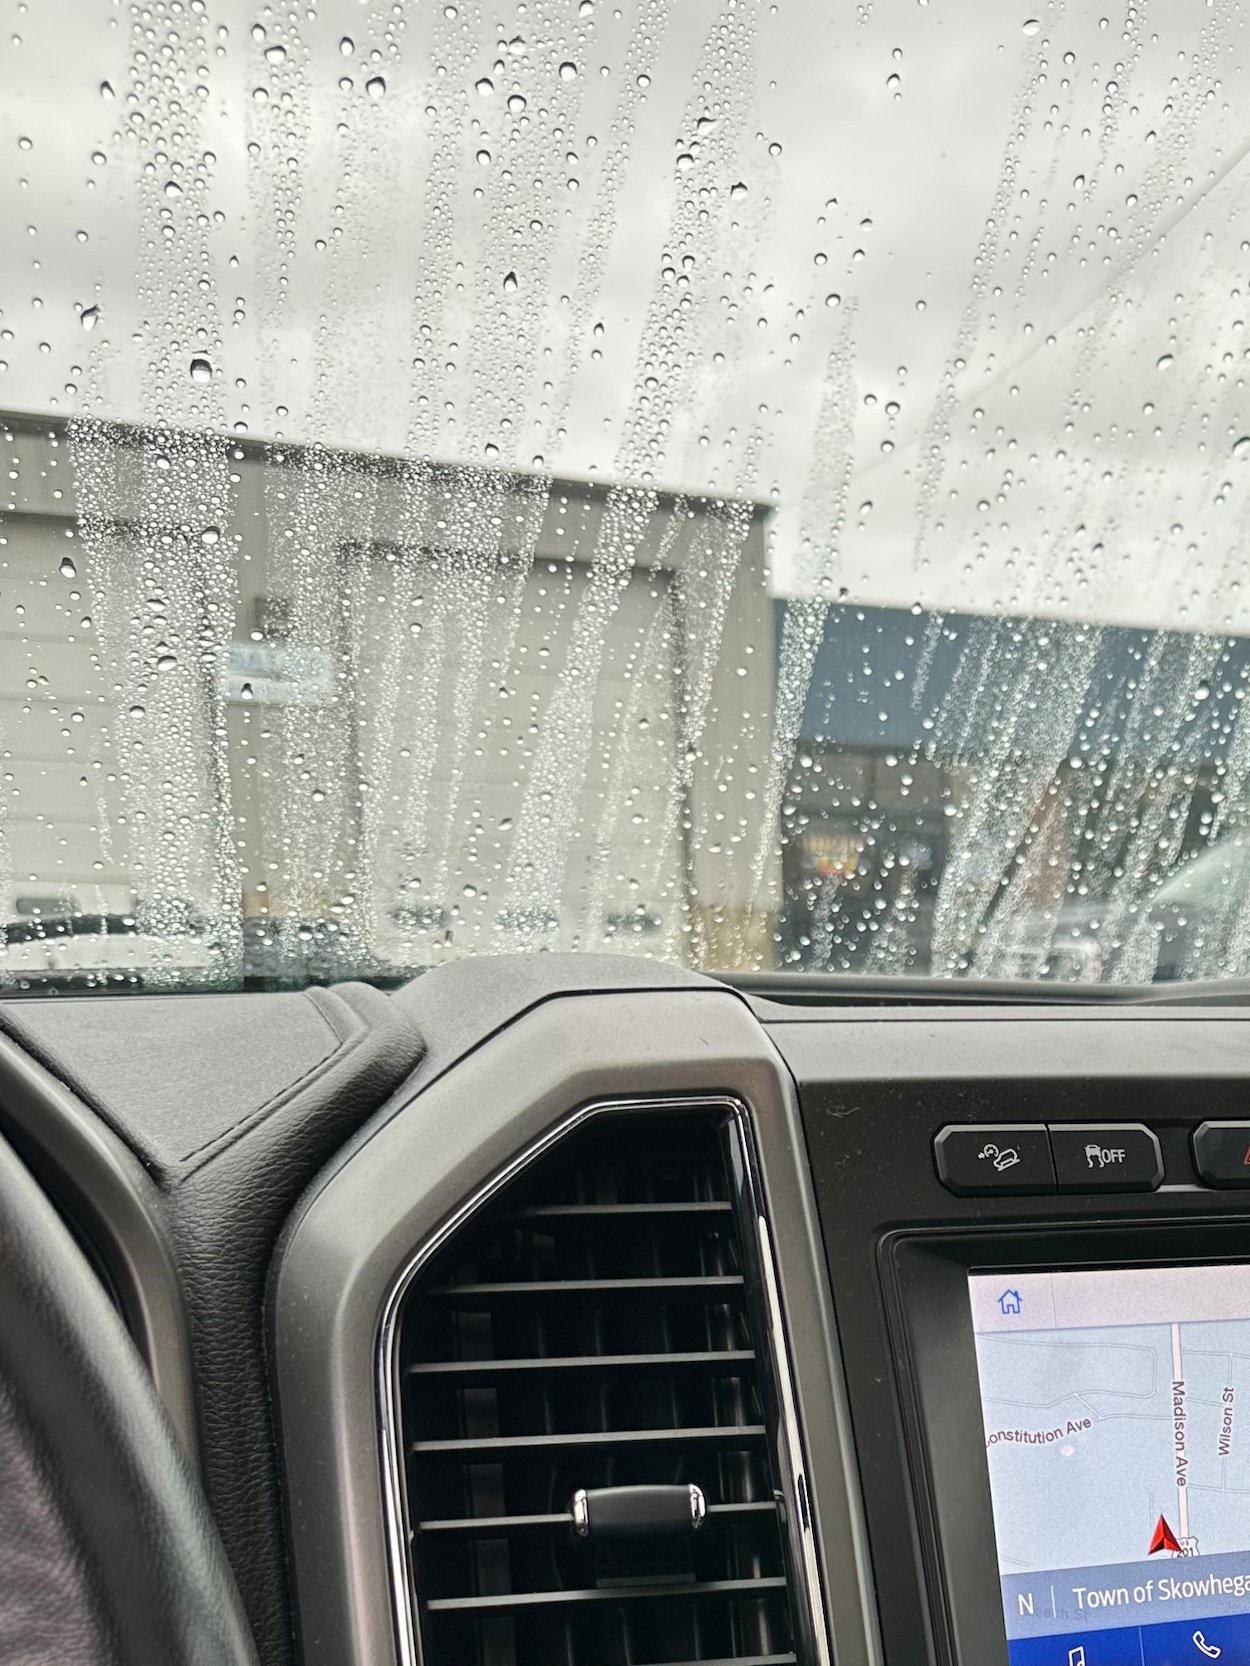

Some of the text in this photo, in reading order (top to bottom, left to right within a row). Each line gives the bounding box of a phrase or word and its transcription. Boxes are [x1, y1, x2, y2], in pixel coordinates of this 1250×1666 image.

[1101, 1149, 1126, 1163] OFF
[1066, 1417, 1092, 1435] Ave
[1172, 1381, 1187, 1487] Madison Ave
[1218, 1387, 1234, 1456] Wilson St
[1018, 1592, 1034, 1615] N
[1073, 1585, 1130, 1610] Town
[1133, 1580, 1154, 1602] of
